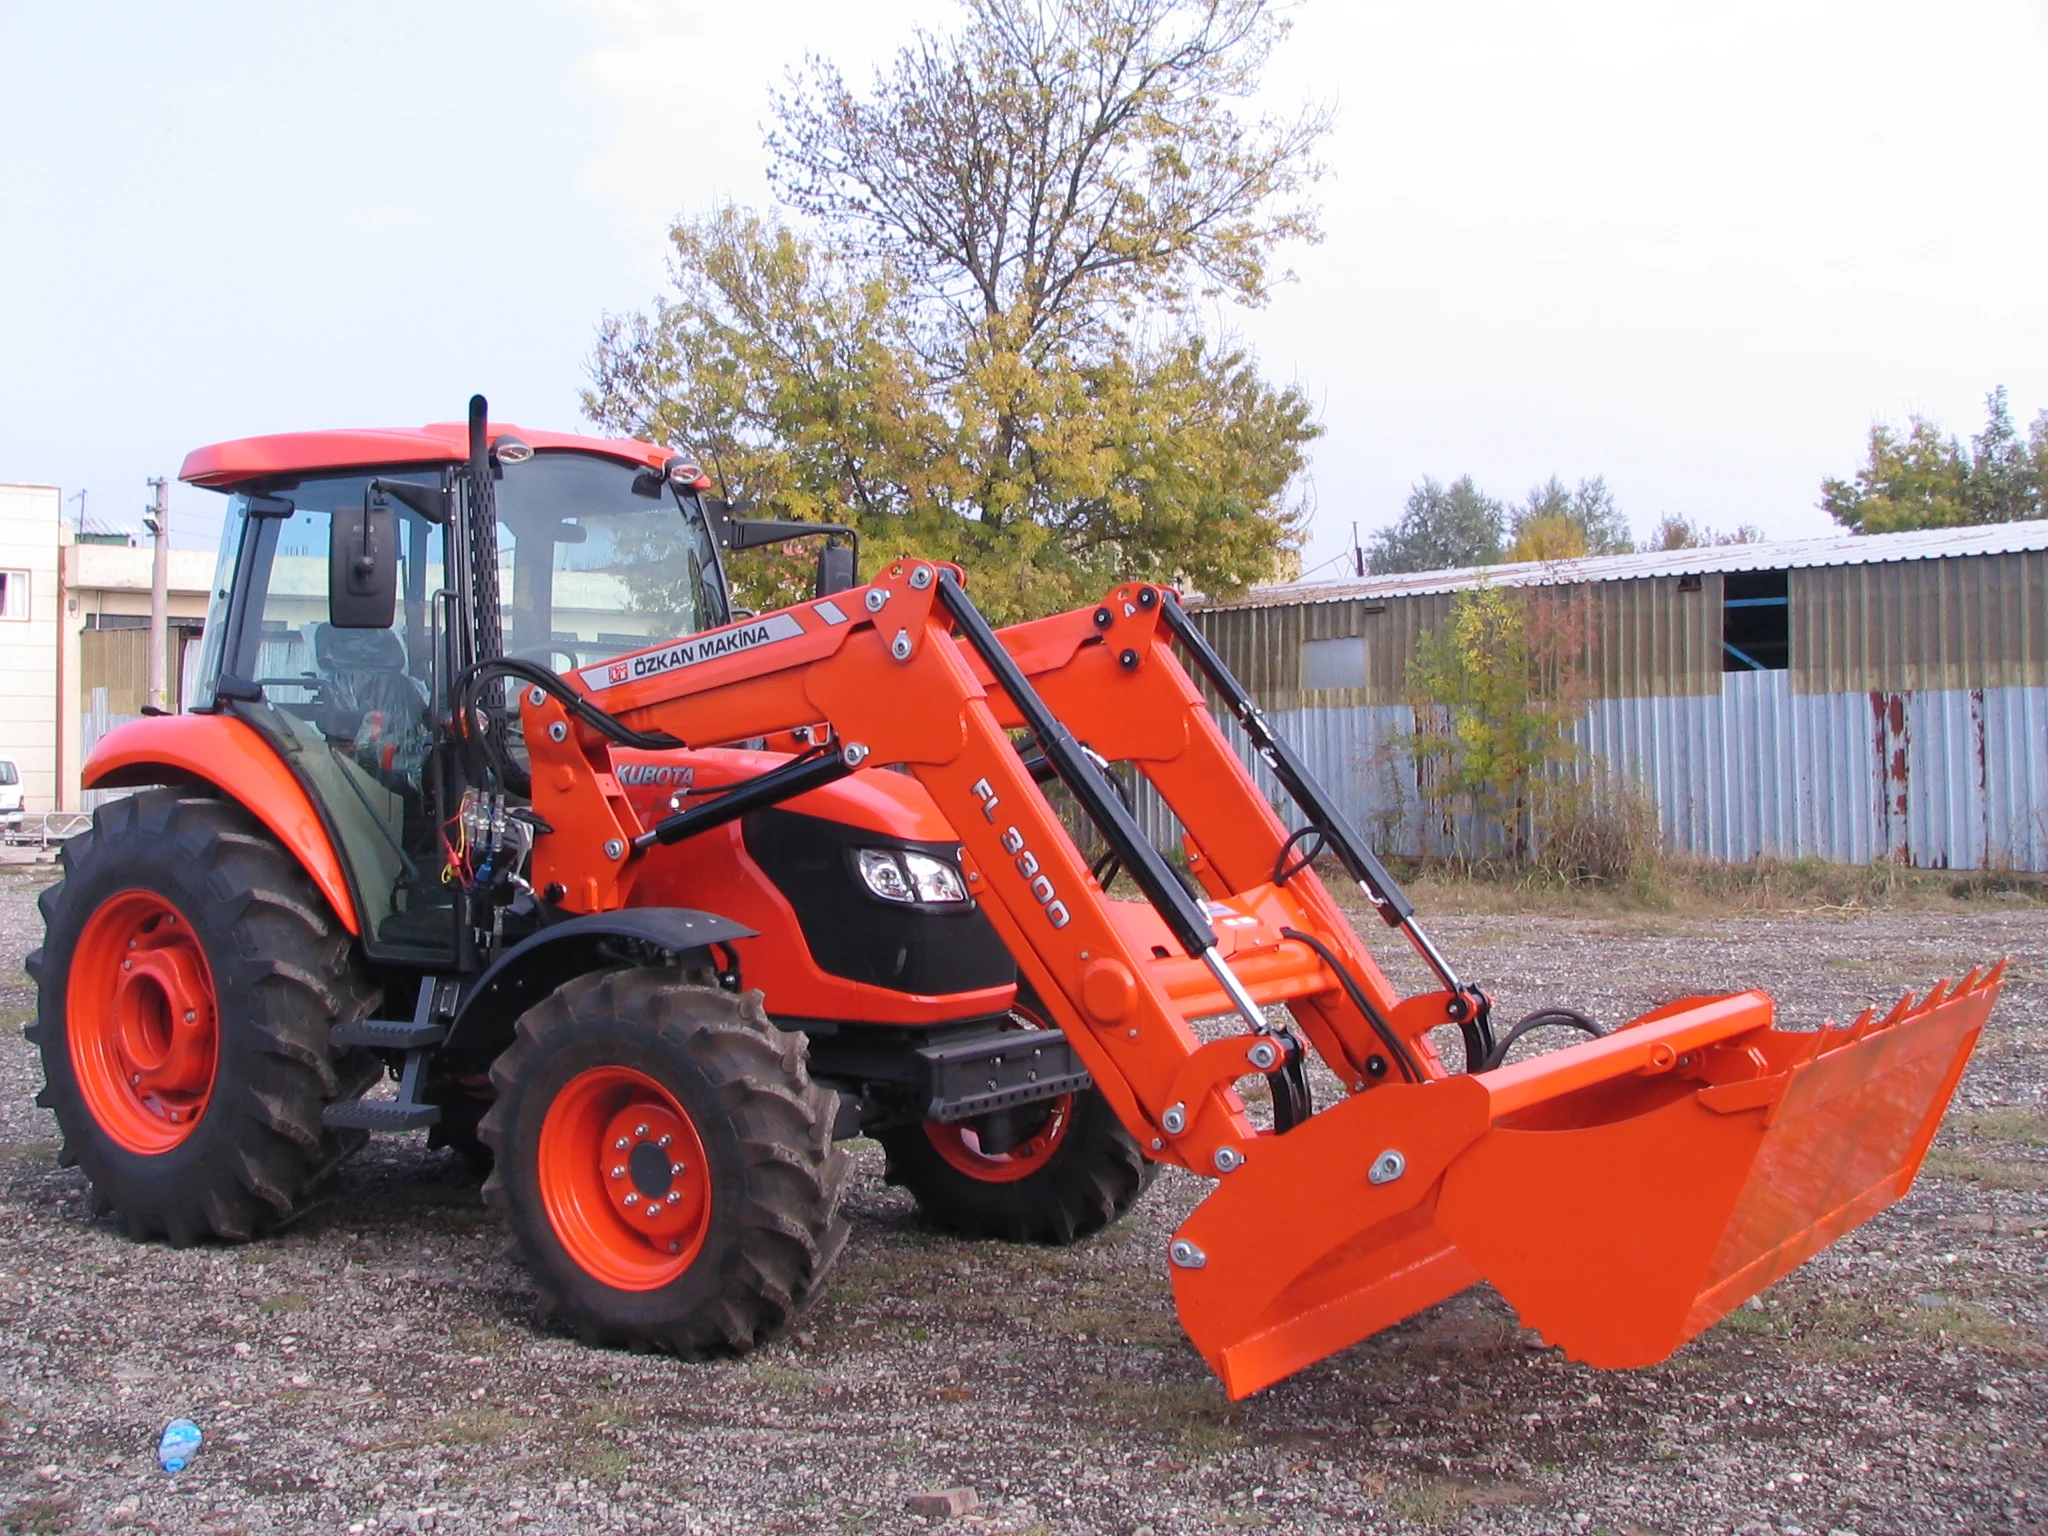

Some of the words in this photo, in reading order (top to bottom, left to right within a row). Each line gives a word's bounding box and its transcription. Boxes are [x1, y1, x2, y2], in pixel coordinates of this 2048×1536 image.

[634, 647, 694, 676] ÖZKAN
[699, 625, 770, 659] MAKİNA
[616, 765, 695, 787] KUBOTA
[970, 777, 999, 824] FL
[1000, 826, 1071, 930] 3300
